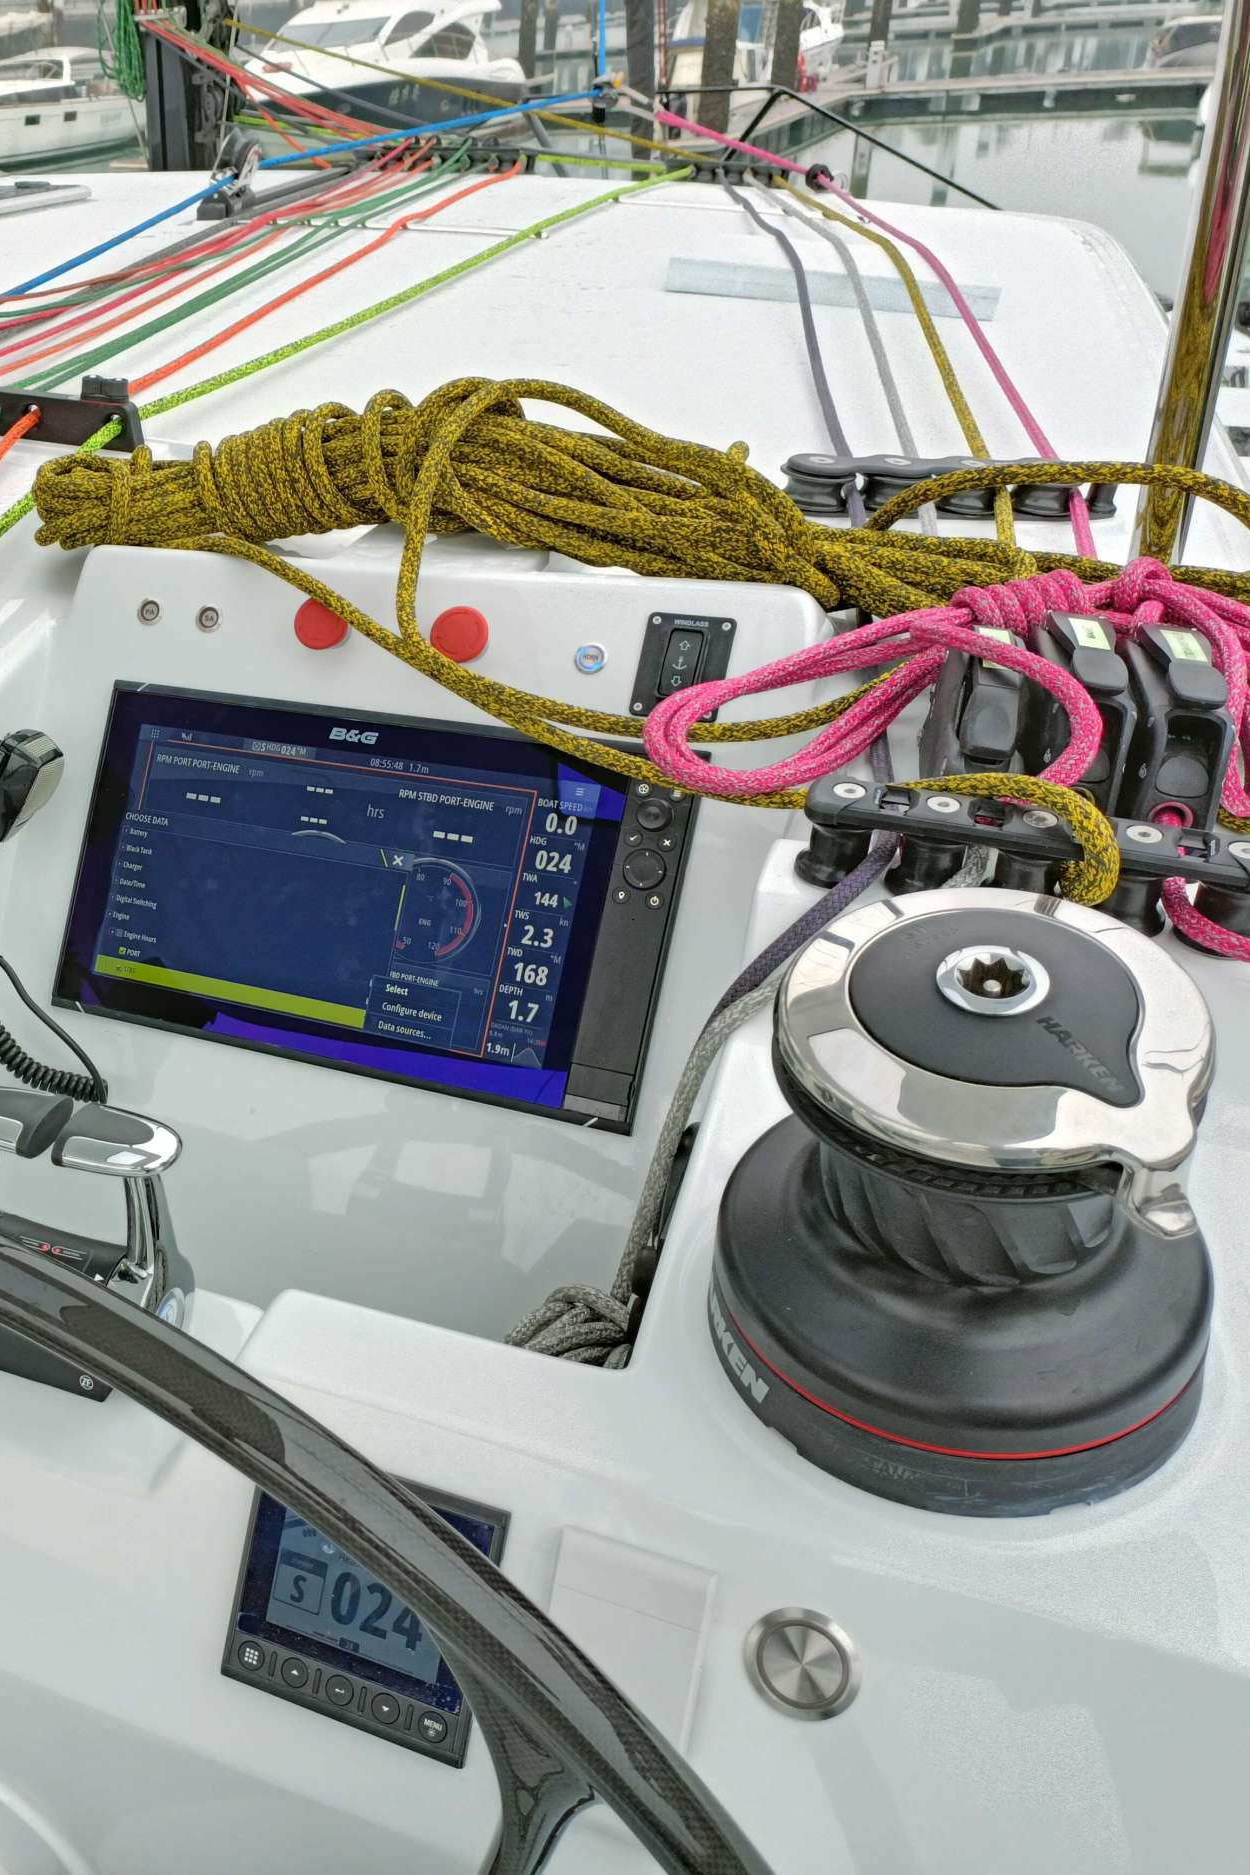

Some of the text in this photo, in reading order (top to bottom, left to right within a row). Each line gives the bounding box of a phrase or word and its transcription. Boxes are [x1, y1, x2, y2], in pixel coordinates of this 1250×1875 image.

[674, 619, 709, 628] WINDLASS
[329, 727, 379, 745] B&G
[156, 753, 264, 778] RPM PORT PORT-ENGINE rpm
[370, 758, 429, 775] 08:55:48 1.7m
[398, 788, 523, 817] RPM STBD PORT-ENGINE rpm
[538, 798, 558, 809] BOAT
[559, 801, 583, 812] SPEED
[126, 811, 169, 827] CHOOSE DATA
[366, 803, 385, 819] hrs
[545, 812, 578, 836] 0.0
[530, 835, 547, 846] HDG
[123, 861, 143, 872] Charger
[534, 849, 572, 874] 024
[119, 878, 146, 889] Date/Time
[523, 872, 538, 883] TWA
[116, 894, 157, 910] Digital Switching
[533, 891, 559, 908] 144
[112, 911, 130, 921] Engine
[515, 909, 569, 927] TWS kn
[124, 930, 157, 944] Engine Hours
[521, 924, 554, 948] 2.3
[126, 947, 141, 958] PORT
[507, 946, 523, 957] TWD
[401, 973, 439, 987] PORT-ENGINE
[514, 962, 549, 986] 168
[385, 983, 409, 996] Select
[499, 983, 523, 997] DEPTH
[382, 1001, 442, 1022] Configure device
[508, 999, 540, 1023] 1.7
[378, 1020, 431, 1040] Data sources...
[486, 1042, 510, 1057] 1.9m
[1036, 1016, 1126, 1092] HARKEN
[290, 1571, 423, 1652] S 024
[424, 1718, 442, 1731] MENU
